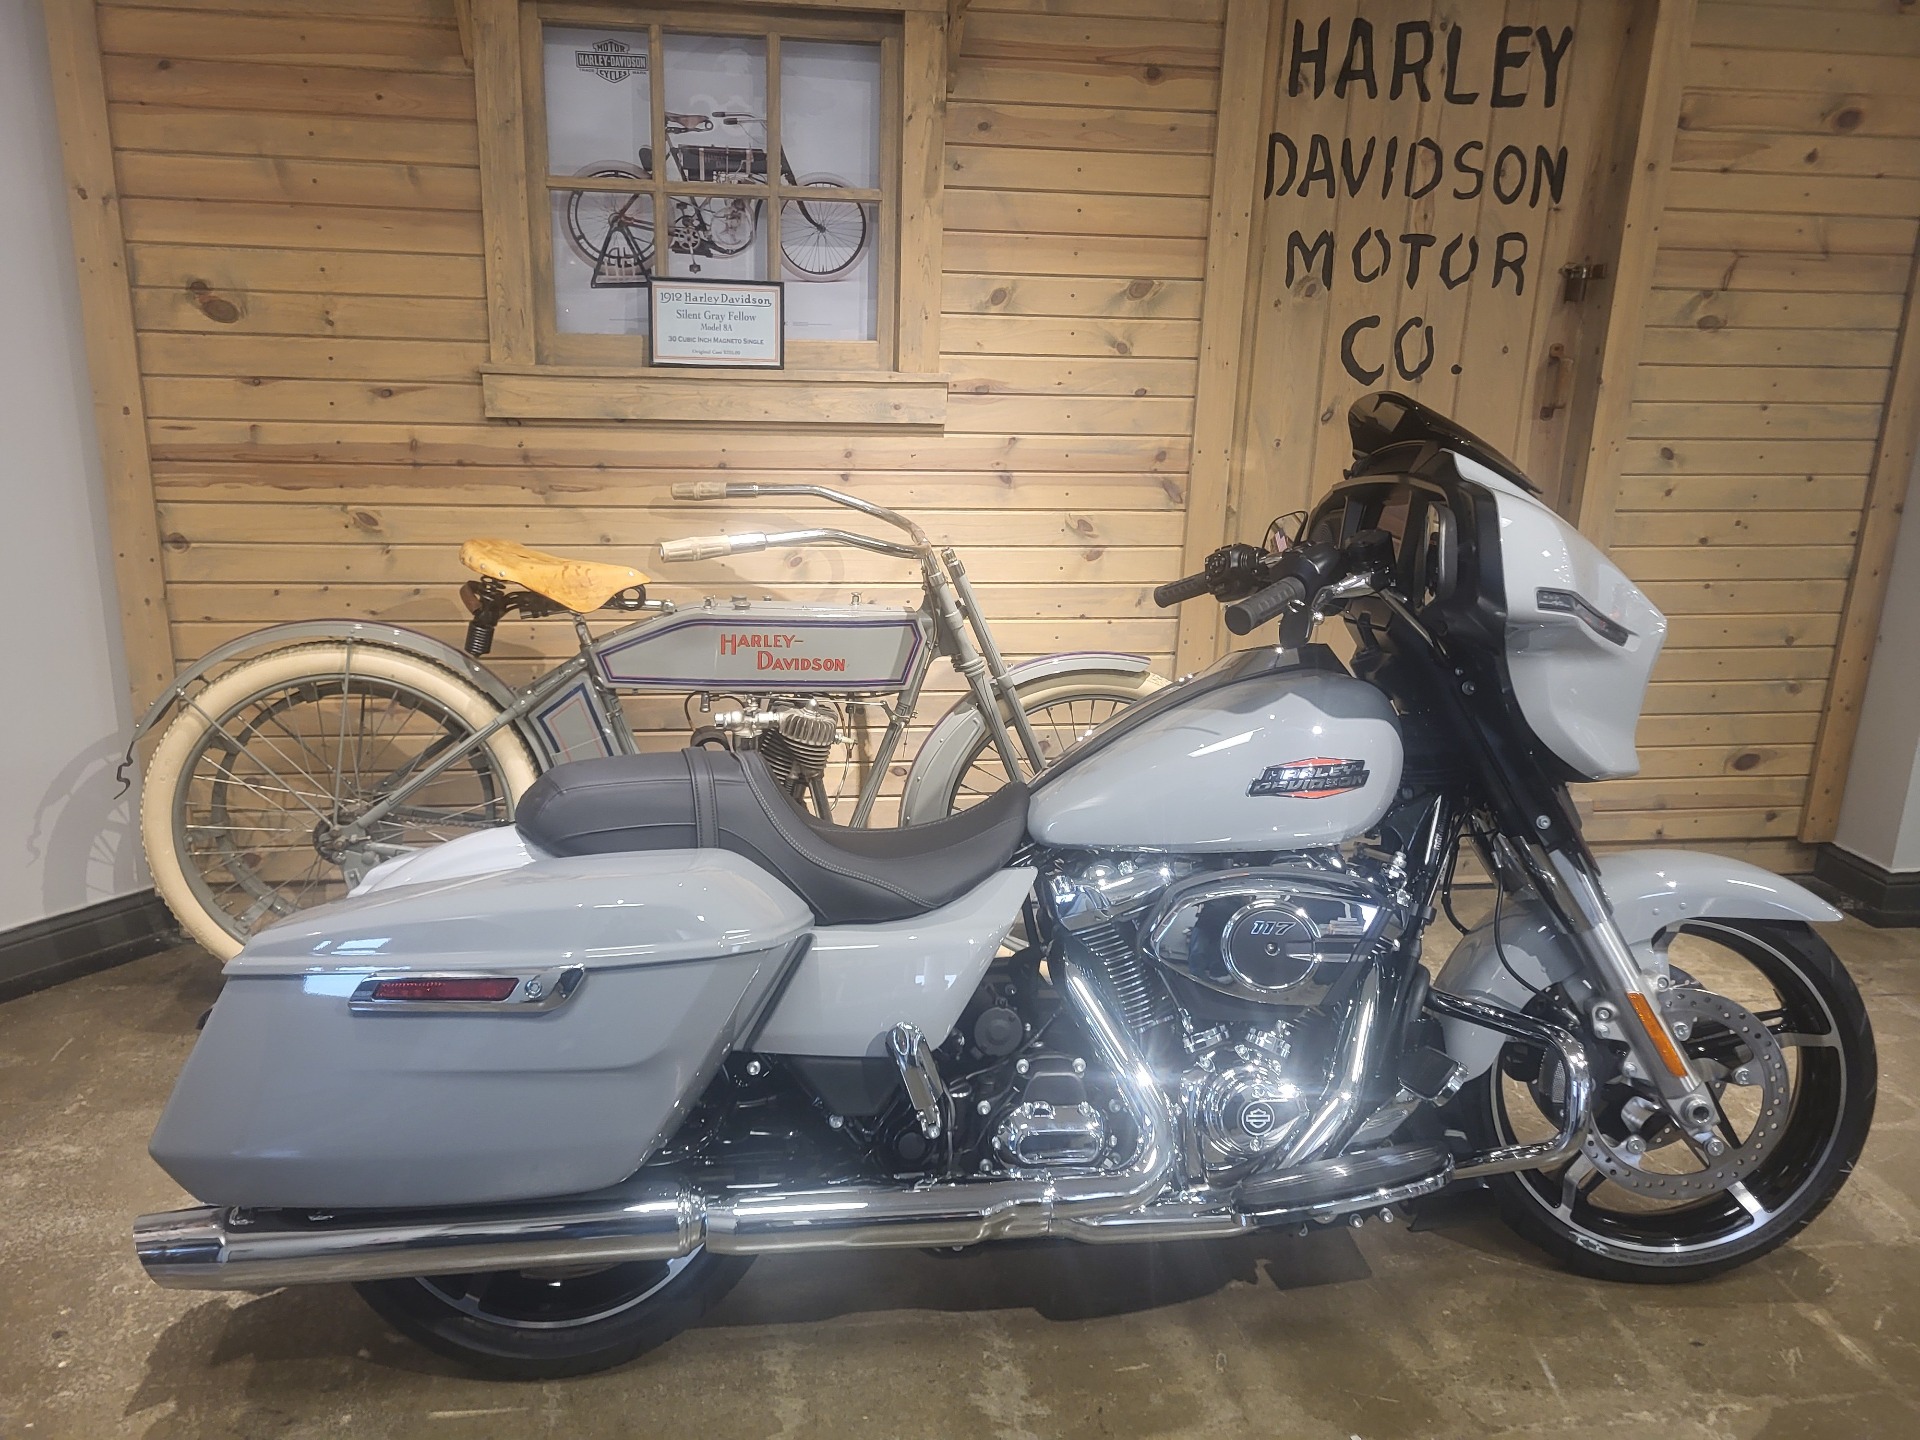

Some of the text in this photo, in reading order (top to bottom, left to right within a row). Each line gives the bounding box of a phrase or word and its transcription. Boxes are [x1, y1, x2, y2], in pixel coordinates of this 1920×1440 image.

[596, 41, 626, 53] MOTOR
[578, 54, 647, 69] HARLEY-DAVIDSON
[1288, 17, 1574, 108] HARLEY
[599, 70, 628, 81] CYCLES
[1263, 132, 1569, 208] DAVIDSON
[1285, 227, 1528, 296] MOTOR
[660, 292, 772, 306] 1912 Harley Davidson
[676, 309, 757, 323] Silent Gray Fellow
[700, 323, 733, 332] Model 8A
[1340, 315, 1463, 386] CO.
[720, 634, 804, 655] HARLEY-
[757, 651, 846, 672] DAVIDSON
[1254, 774, 1366, 791] DAVIDSON
[1250, 921, 1297, 935] 117
